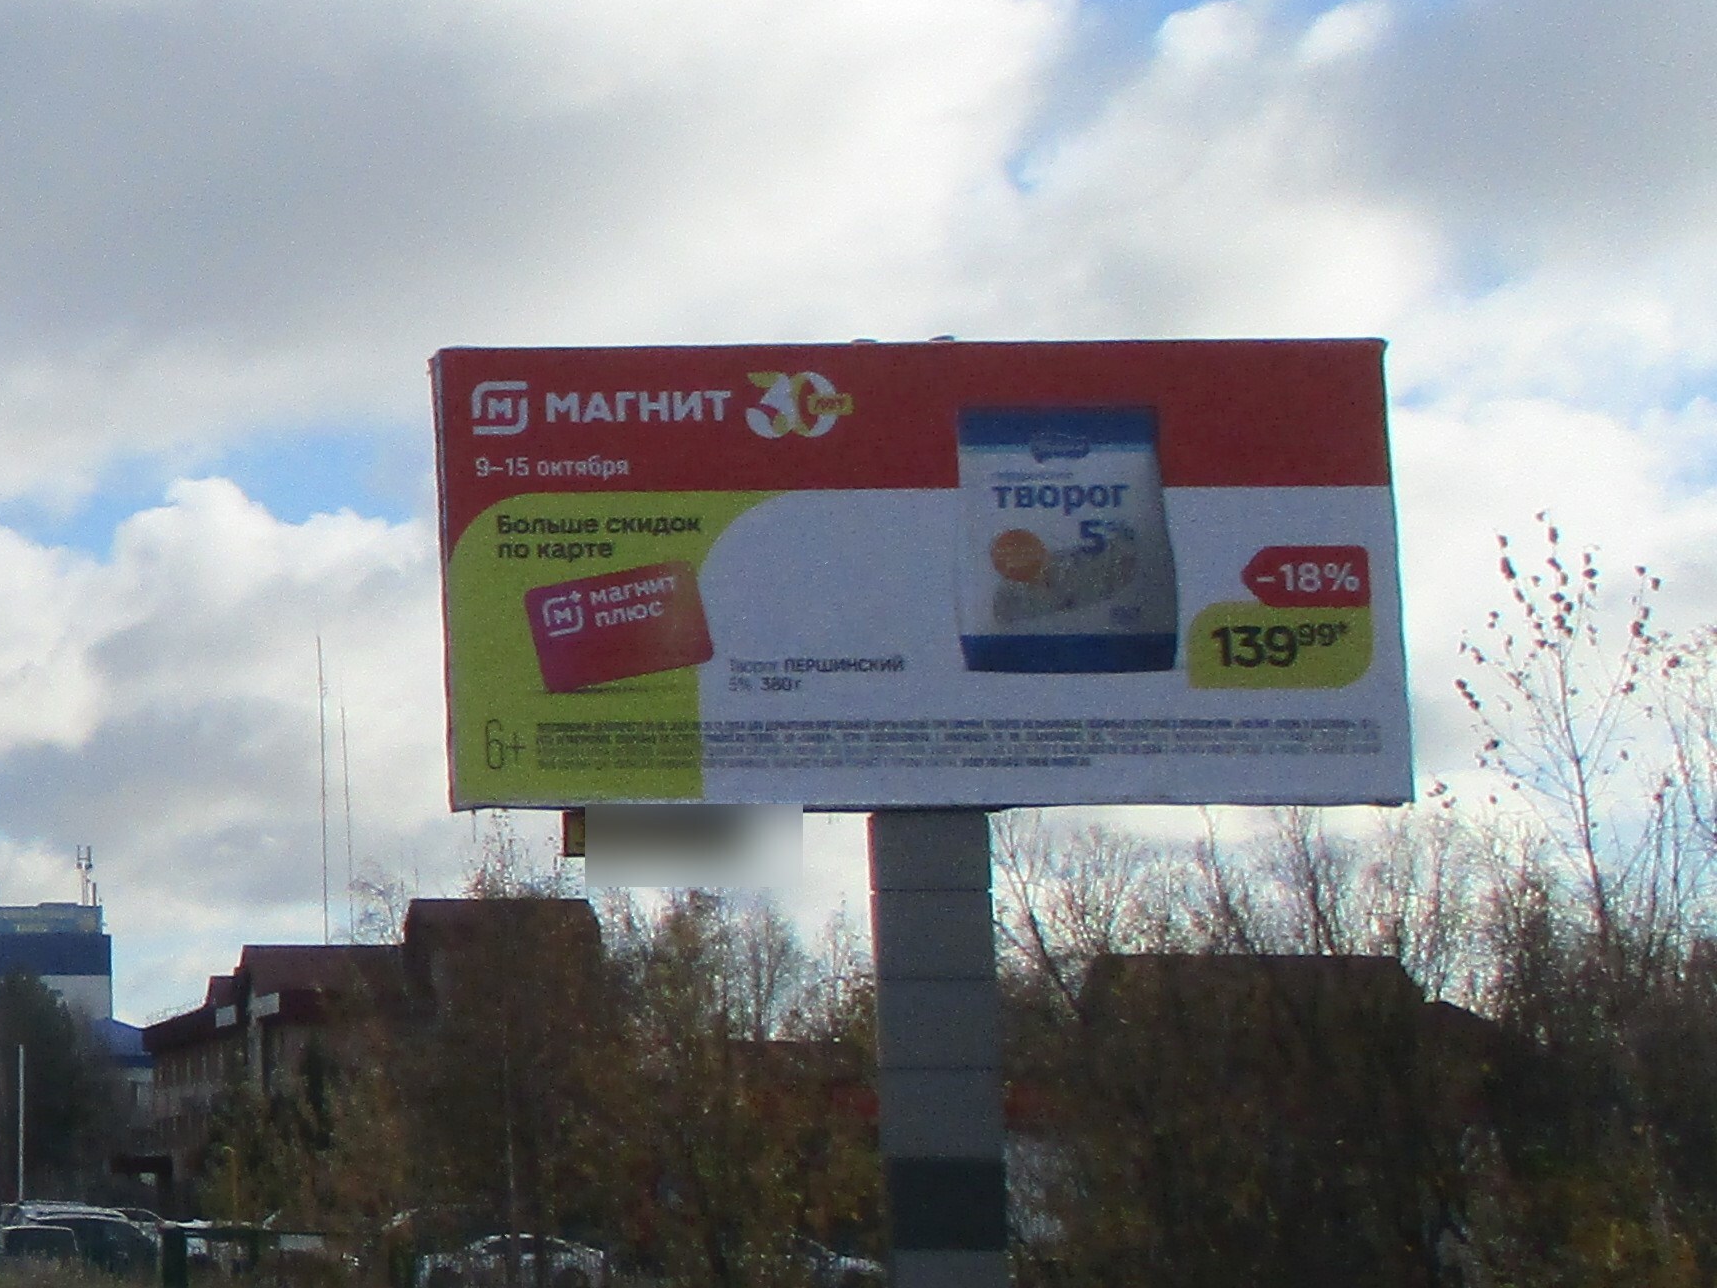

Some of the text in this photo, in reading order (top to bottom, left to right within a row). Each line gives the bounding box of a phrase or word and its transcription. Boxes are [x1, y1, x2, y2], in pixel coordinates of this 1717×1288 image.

[545, 390, 732, 423] МАГНИТ
[536, 455, 632, 481] октября
[496, 514, 702, 535] Больше скидок
[497, 542, 614, 562] по карте
[593, 601, 666, 629] плюс
[484, 718, 526, 770] 6+
